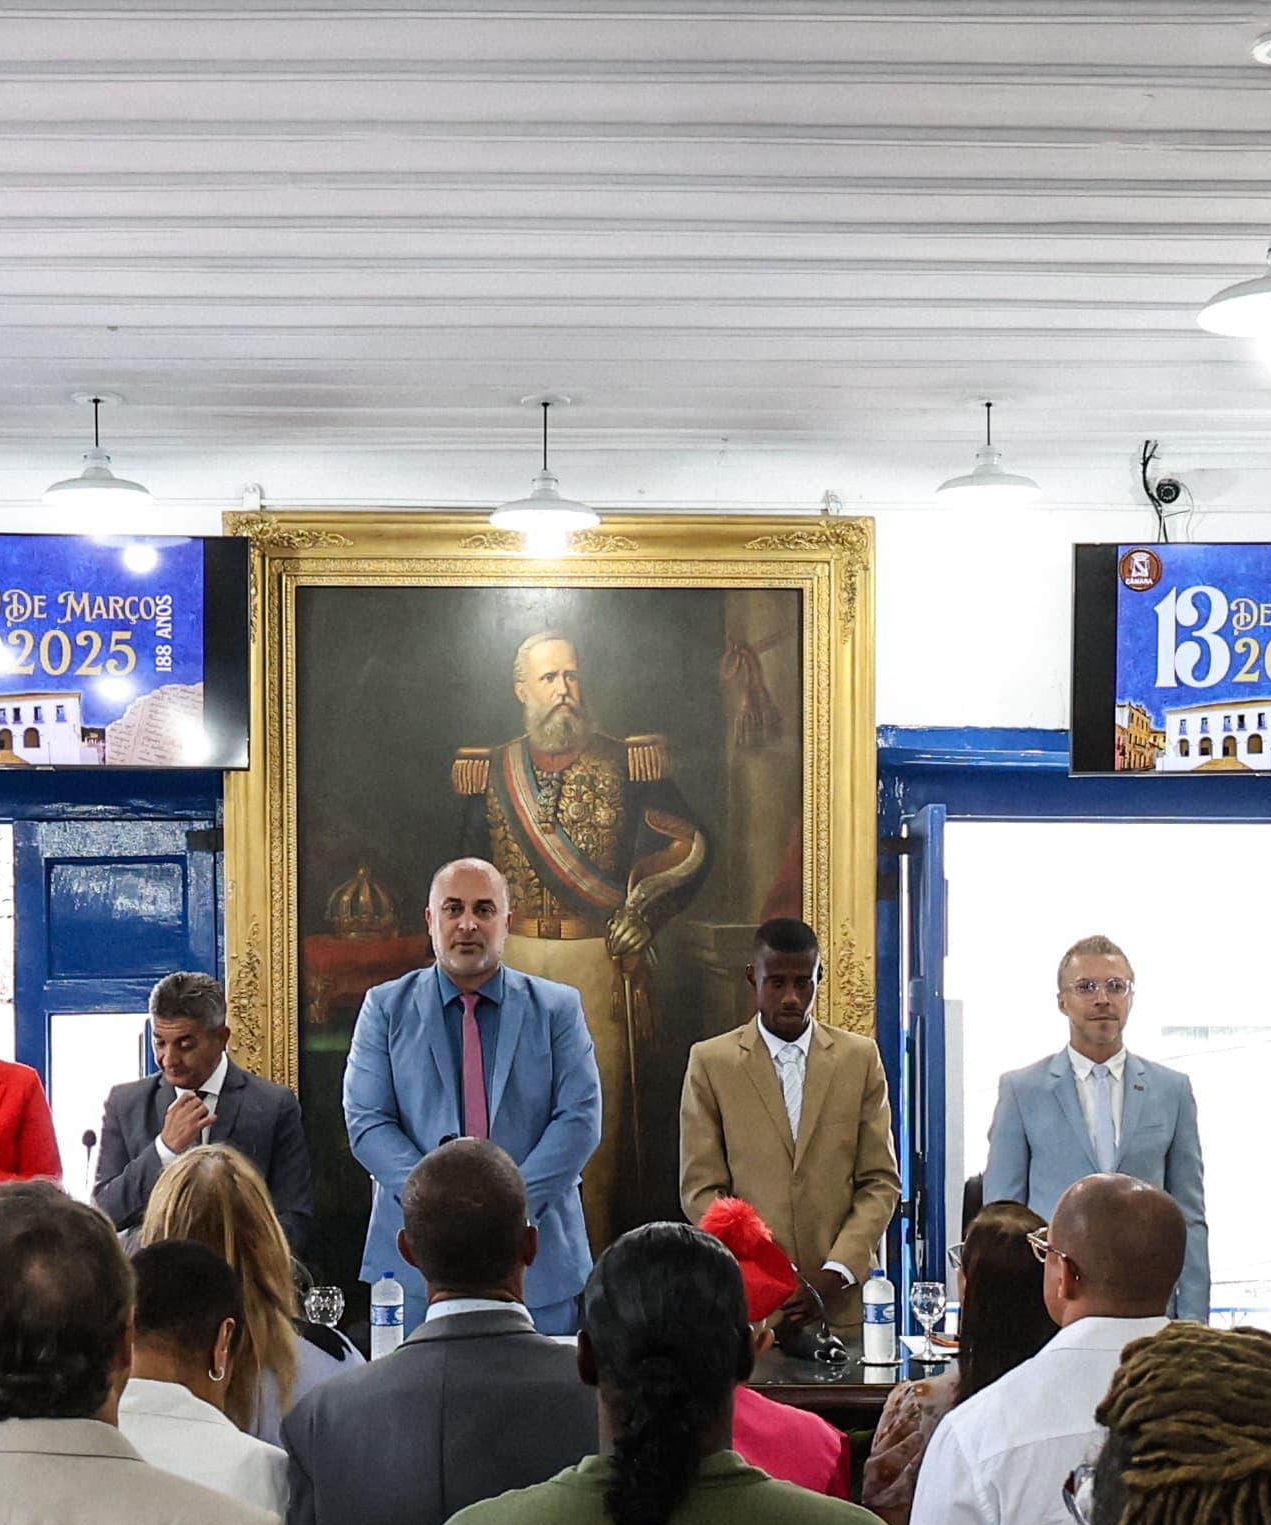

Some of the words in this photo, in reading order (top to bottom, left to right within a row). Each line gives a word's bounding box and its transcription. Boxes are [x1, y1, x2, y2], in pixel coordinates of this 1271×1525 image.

[57, 591, 155, 625] MARÇO
[155, 594, 173, 639] ANOS
[8, 629, 137, 676] 2025
[155, 645, 173, 673] 188
[1153, 585, 1231, 688] 13
